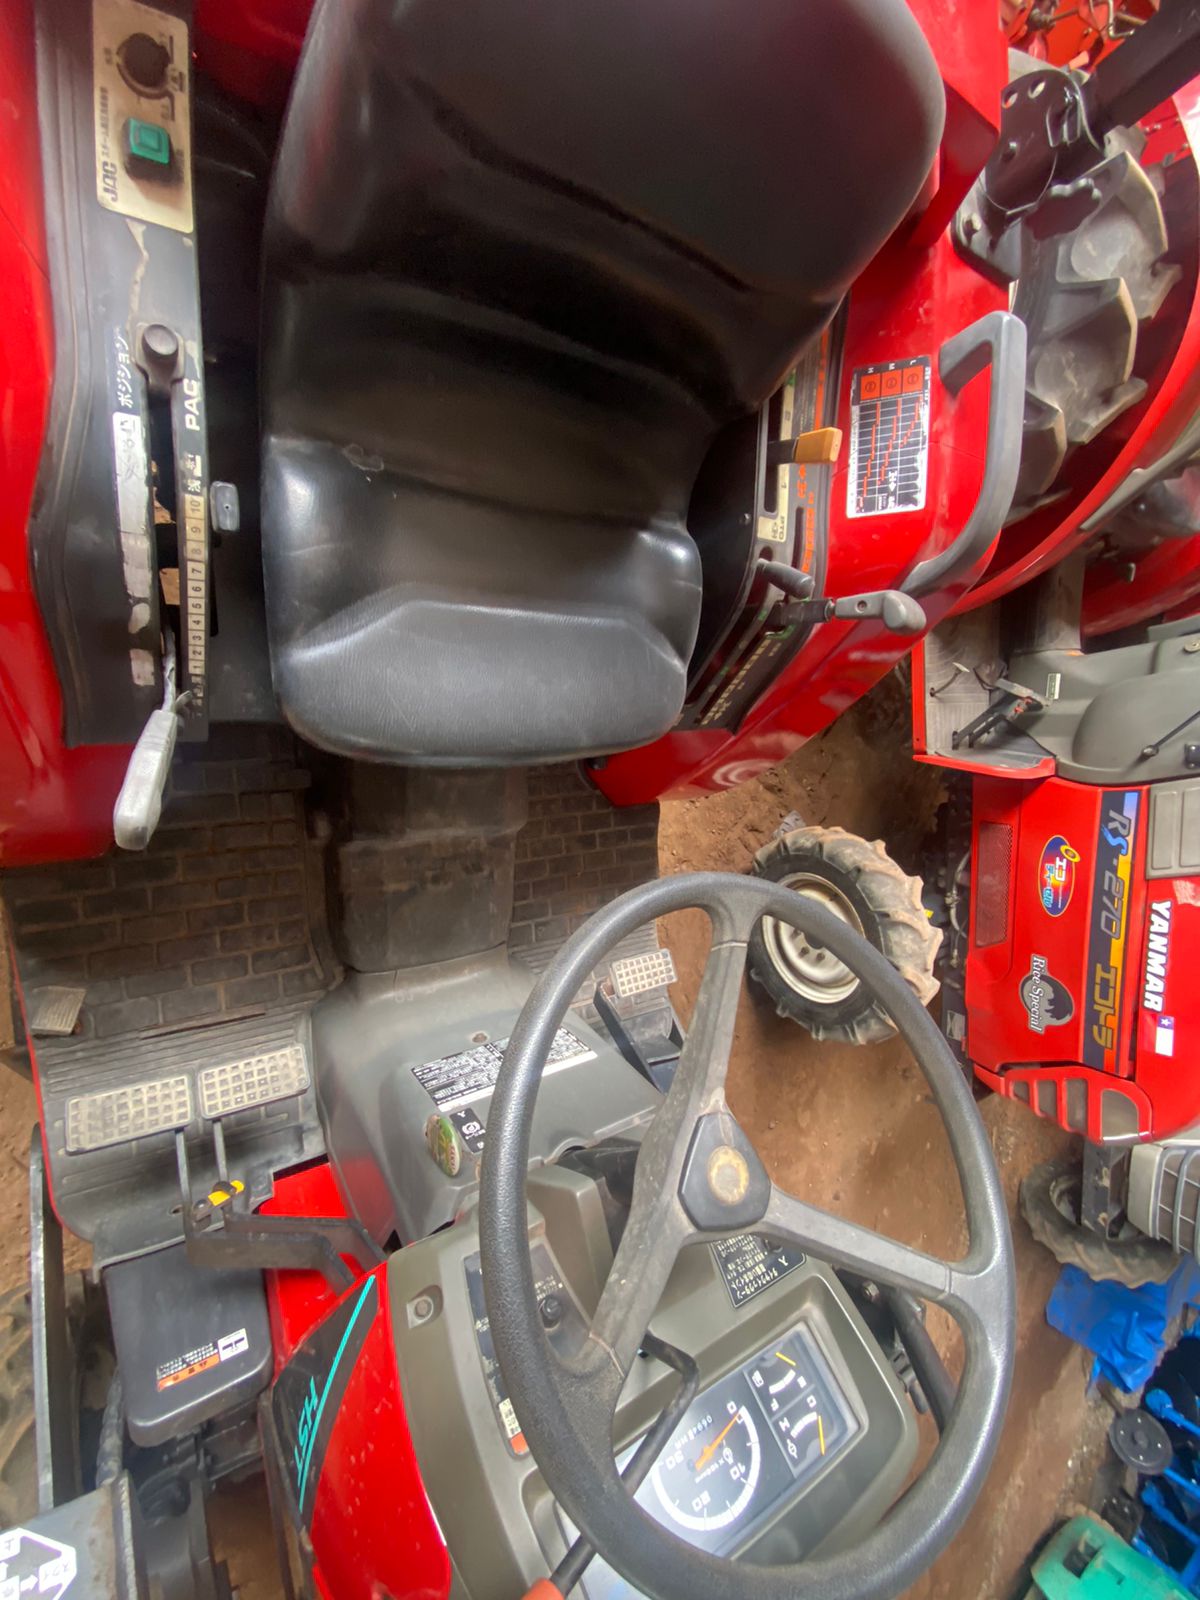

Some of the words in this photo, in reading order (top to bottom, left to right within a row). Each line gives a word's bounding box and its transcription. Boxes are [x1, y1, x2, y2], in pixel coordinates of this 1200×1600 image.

[102, 160, 118, 202] JAC
[115, 335, 133, 409] ポジション
[183, 377, 201, 432] PAC
[189, 499, 202, 514] 10
[1031, 955, 1047, 984] Rice
[1143, 900, 1172, 1014] YANMAR
[1029, 985, 1045, 1032] Special
[1092, 962, 1118, 1049] エコトラ
[727, 1401, 738, 1414] 0
[770, 1397, 780, 1412] F
[807, 1396, 818, 1408] C
[293, 1375, 320, 1489] HST
[778, 1417, 791, 1433] H
[664, 1448, 685, 1471] 30
[729, 1462, 747, 1481] 10
[691, 1490, 712, 1512] 20
